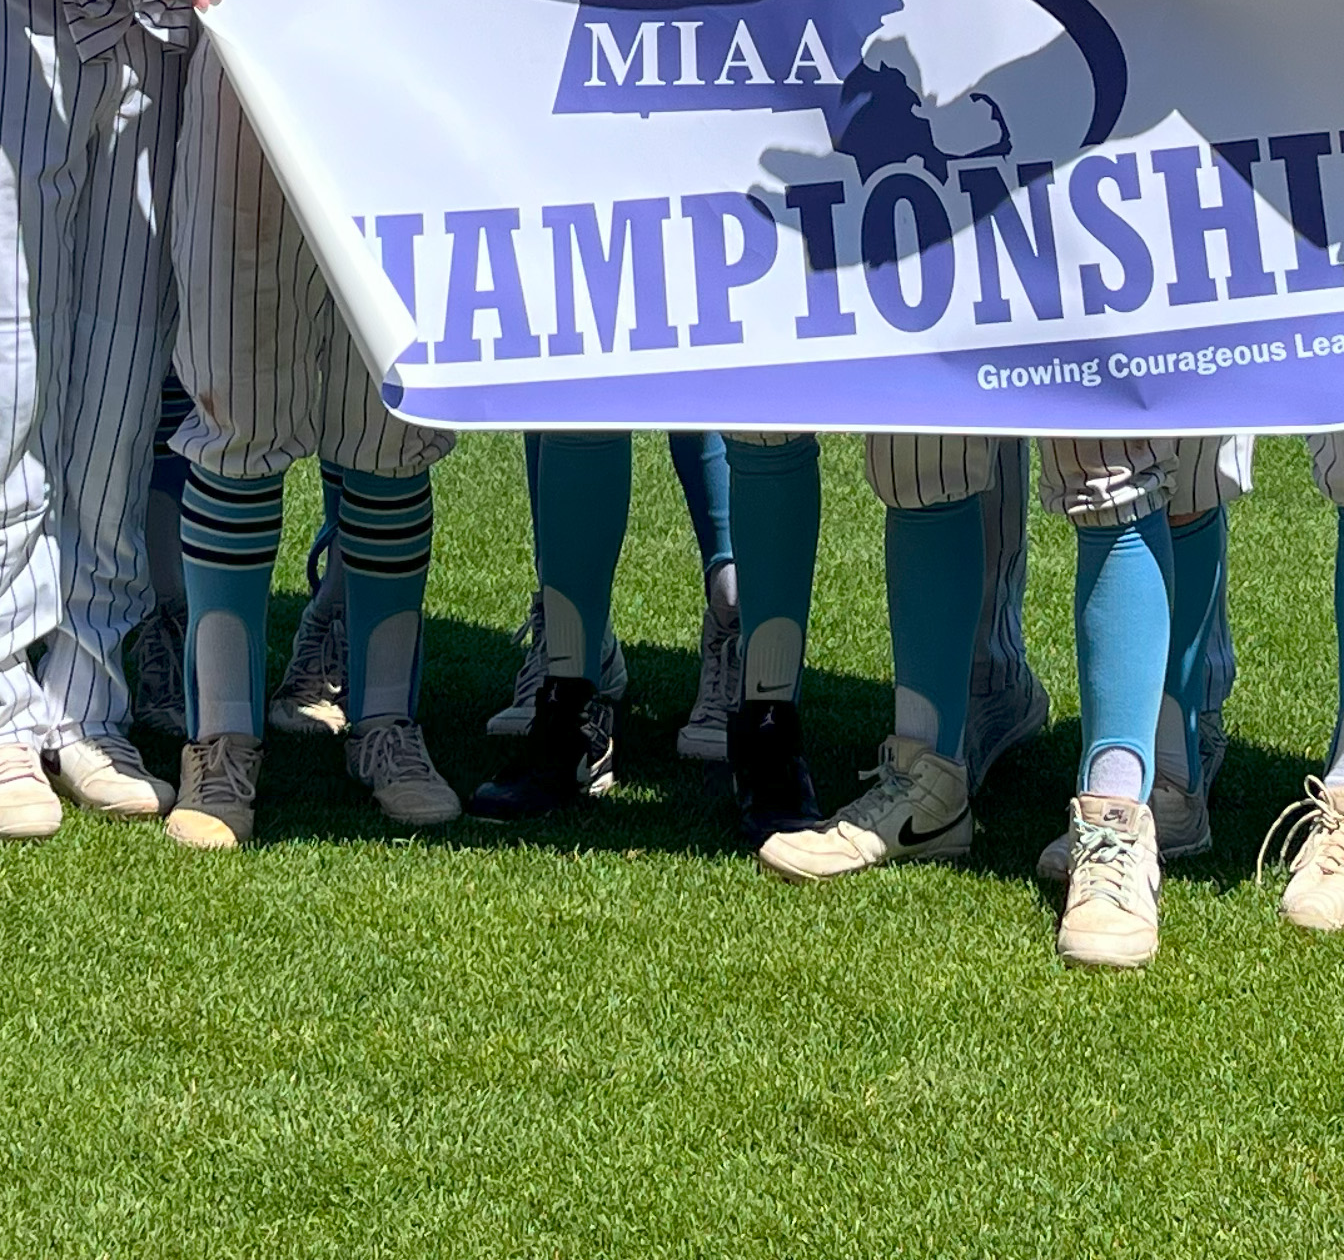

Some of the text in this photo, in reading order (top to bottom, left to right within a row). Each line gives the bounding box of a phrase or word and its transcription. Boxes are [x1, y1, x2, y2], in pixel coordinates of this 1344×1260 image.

[583, 18, 845, 87] MIAA
[977, 348, 1101, 391] Growing
[1108, 338, 1288, 380] Courageous
